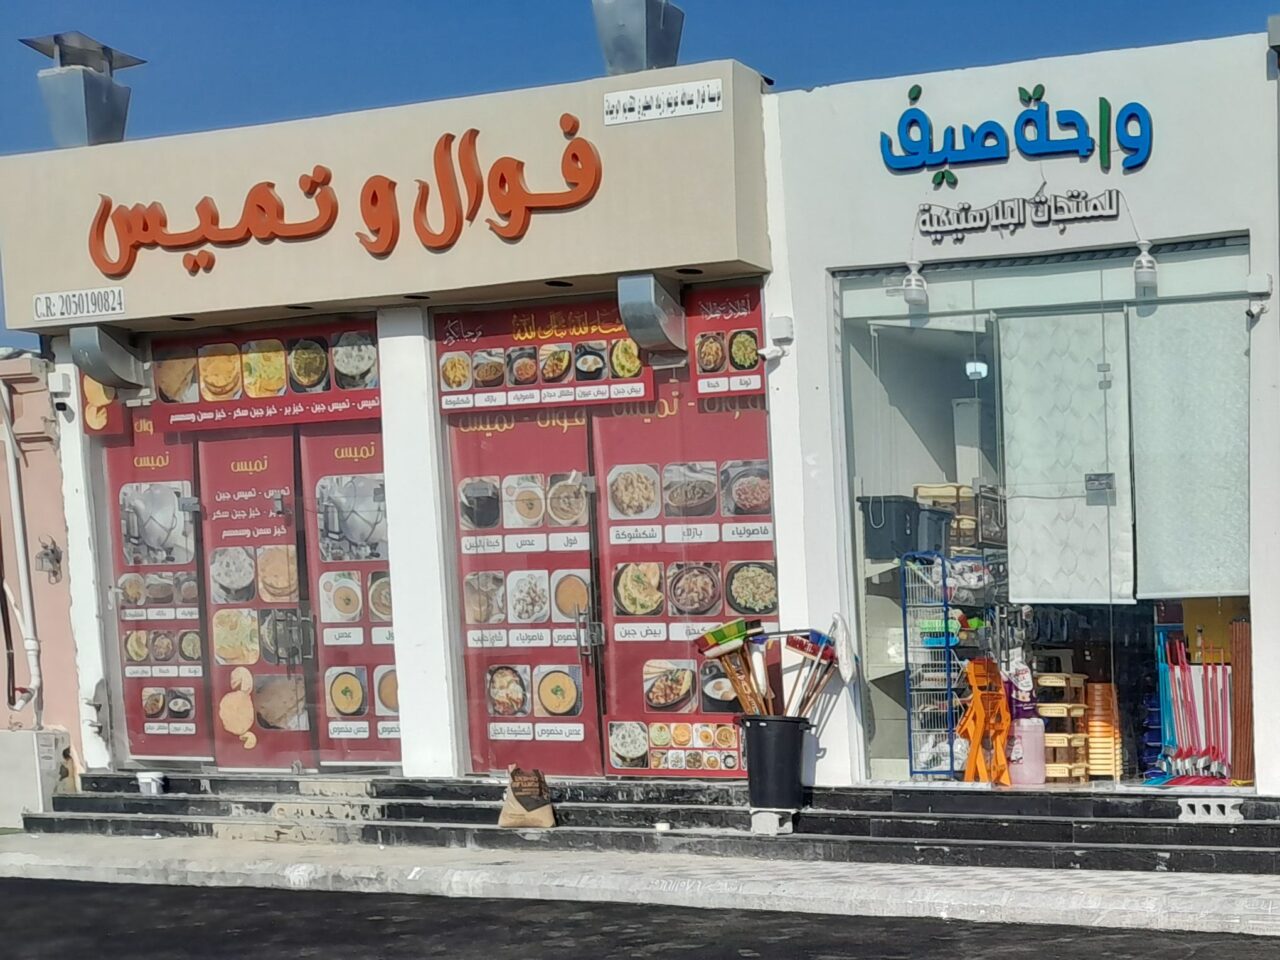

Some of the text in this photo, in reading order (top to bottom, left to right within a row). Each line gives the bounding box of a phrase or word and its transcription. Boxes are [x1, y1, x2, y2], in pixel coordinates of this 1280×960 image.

[880, 83, 1153, 189] واحة صيف
[412, 112, 604, 251] فوال
[918, 189, 1120, 244] للمنتجات البلاستيكية
[59, 289, 123, 316] 2050190824
[327, 399, 350, 412] تميس
[133, 451, 170, 470] تميس
[334, 441, 376, 461] تميس
[230, 455, 268, 475] تميس
